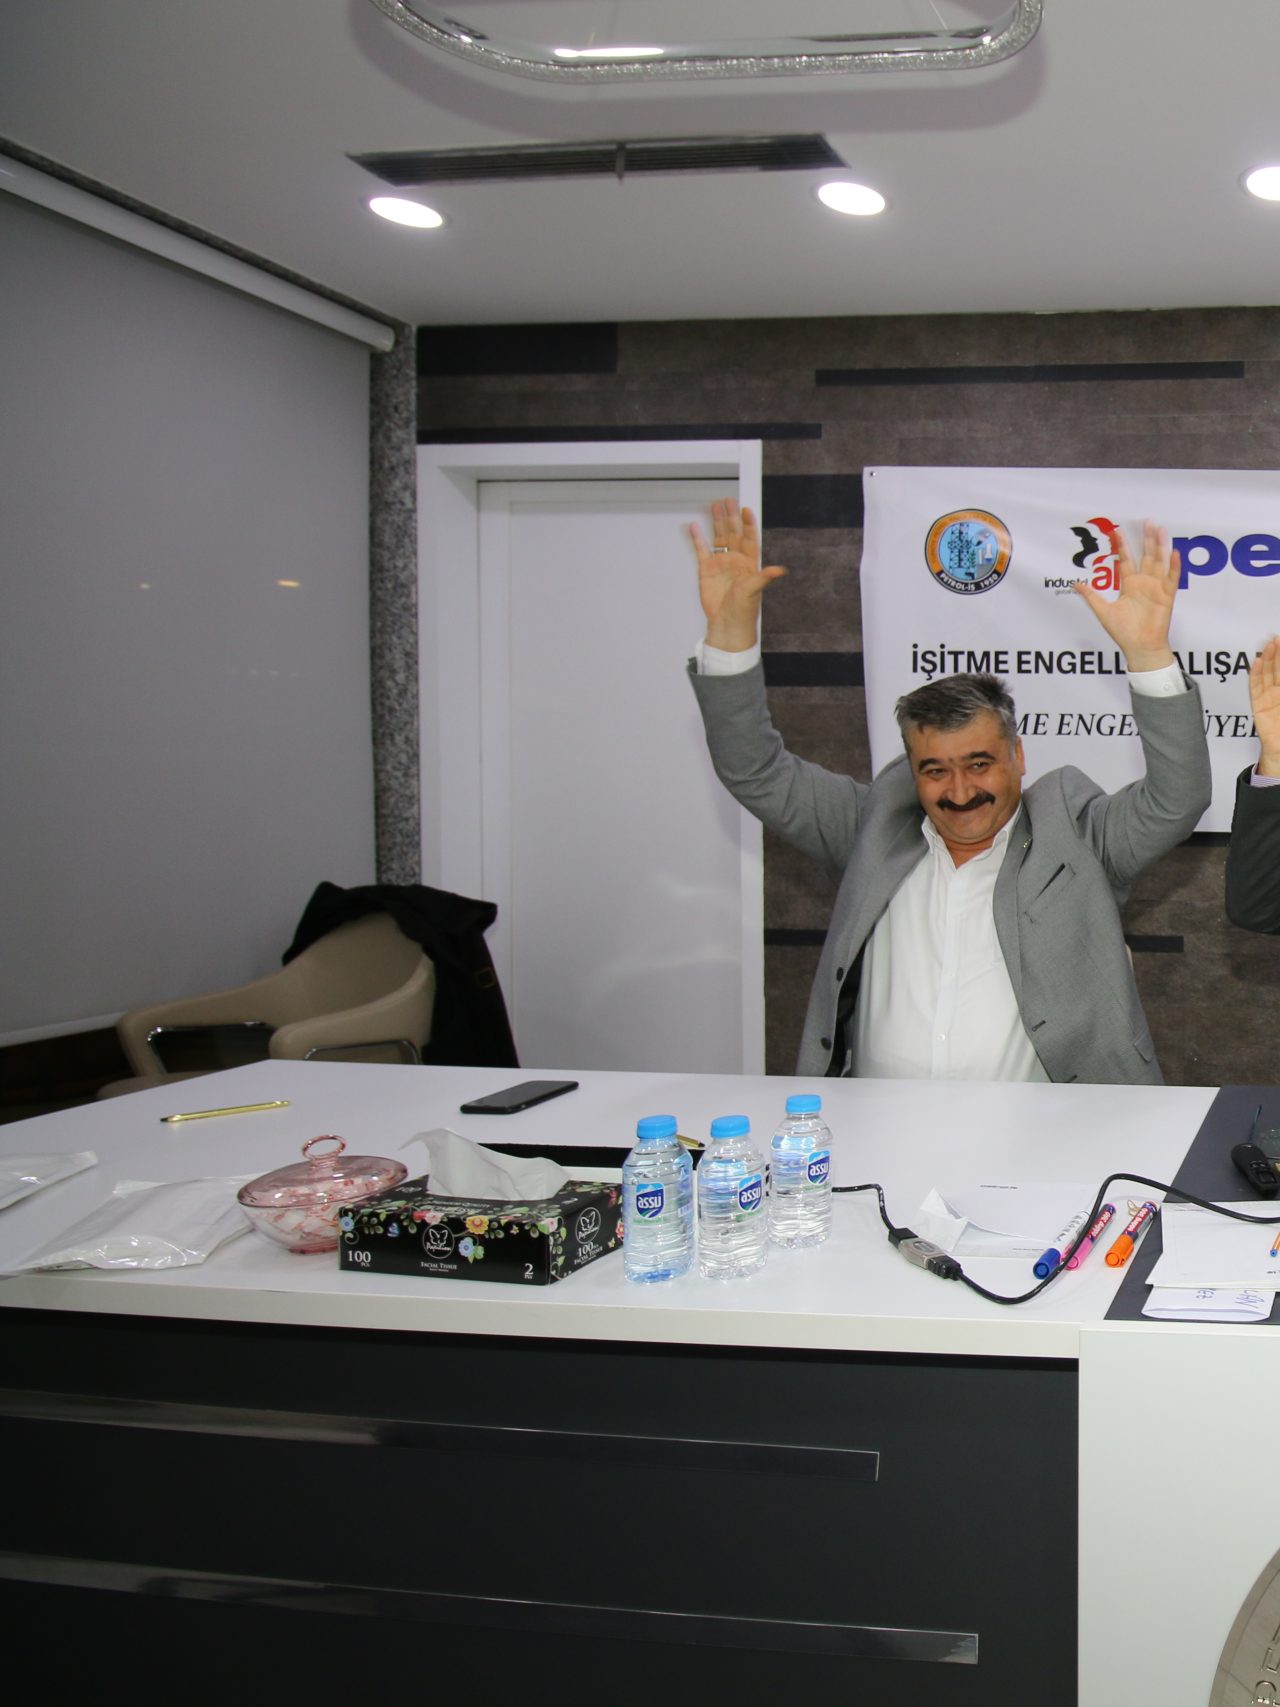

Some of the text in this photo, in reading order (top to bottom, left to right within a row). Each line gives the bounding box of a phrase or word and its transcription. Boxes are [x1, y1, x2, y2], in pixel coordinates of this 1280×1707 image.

[1091, 559, 1121, 591] al
[912, 643, 1009, 680] İŞİTME
[1016, 650, 1127, 675] ENGELL
[347, 1250, 371, 1263] 100
[578, 1241, 595, 1257] 100
[524, 1262, 534, 1275] 2
